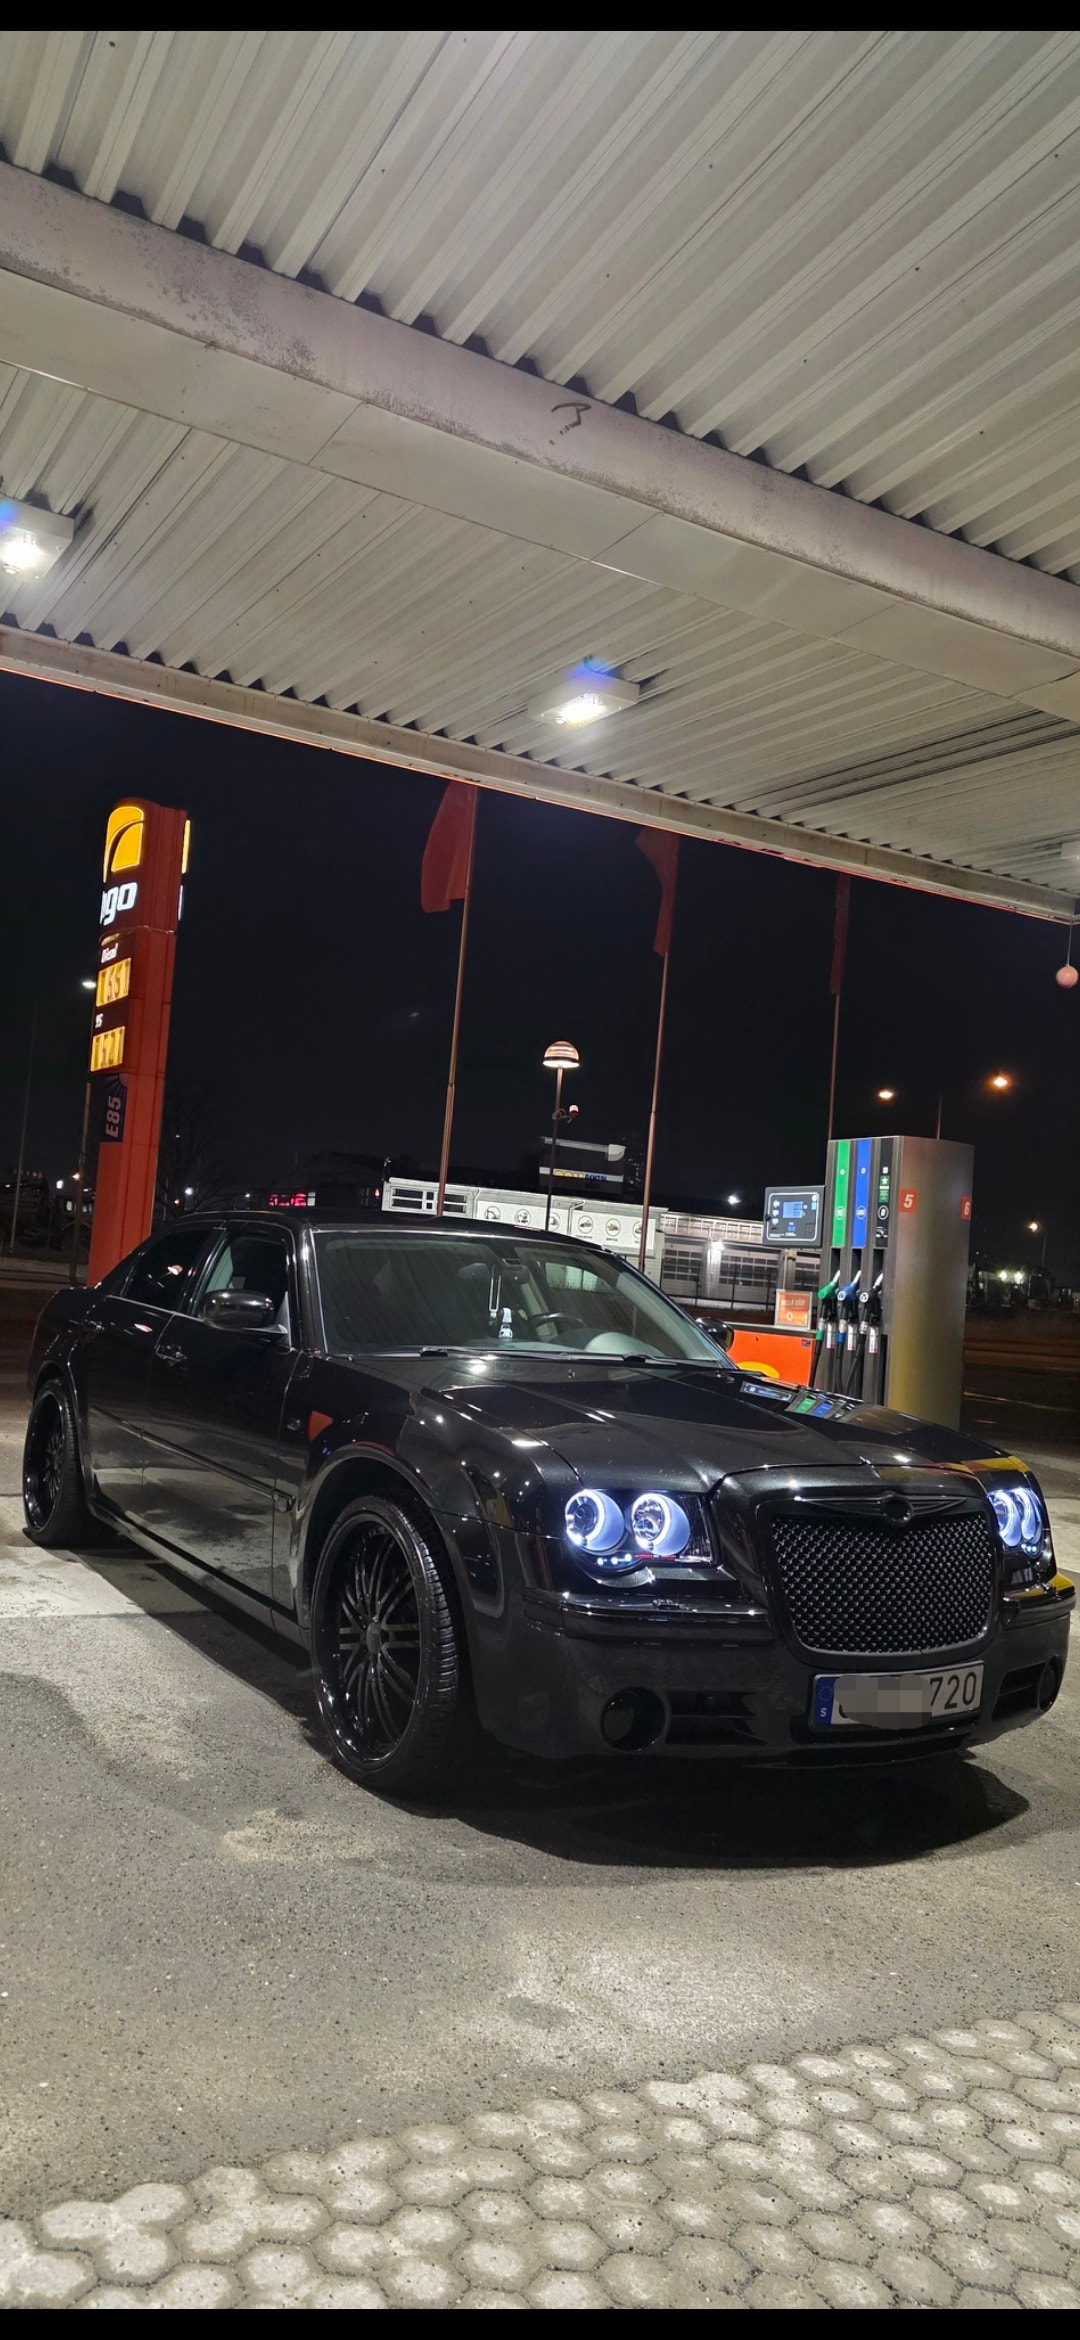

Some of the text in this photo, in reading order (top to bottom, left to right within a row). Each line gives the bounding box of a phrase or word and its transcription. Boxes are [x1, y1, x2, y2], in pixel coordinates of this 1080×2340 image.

[105, 1095, 121, 1138] E85
[903, 1193, 915, 1209] 5
[963, 1201, 971, 1216] 6
[930, 1671, 977, 1710] 720
[820, 1707, 827, 1718] S
